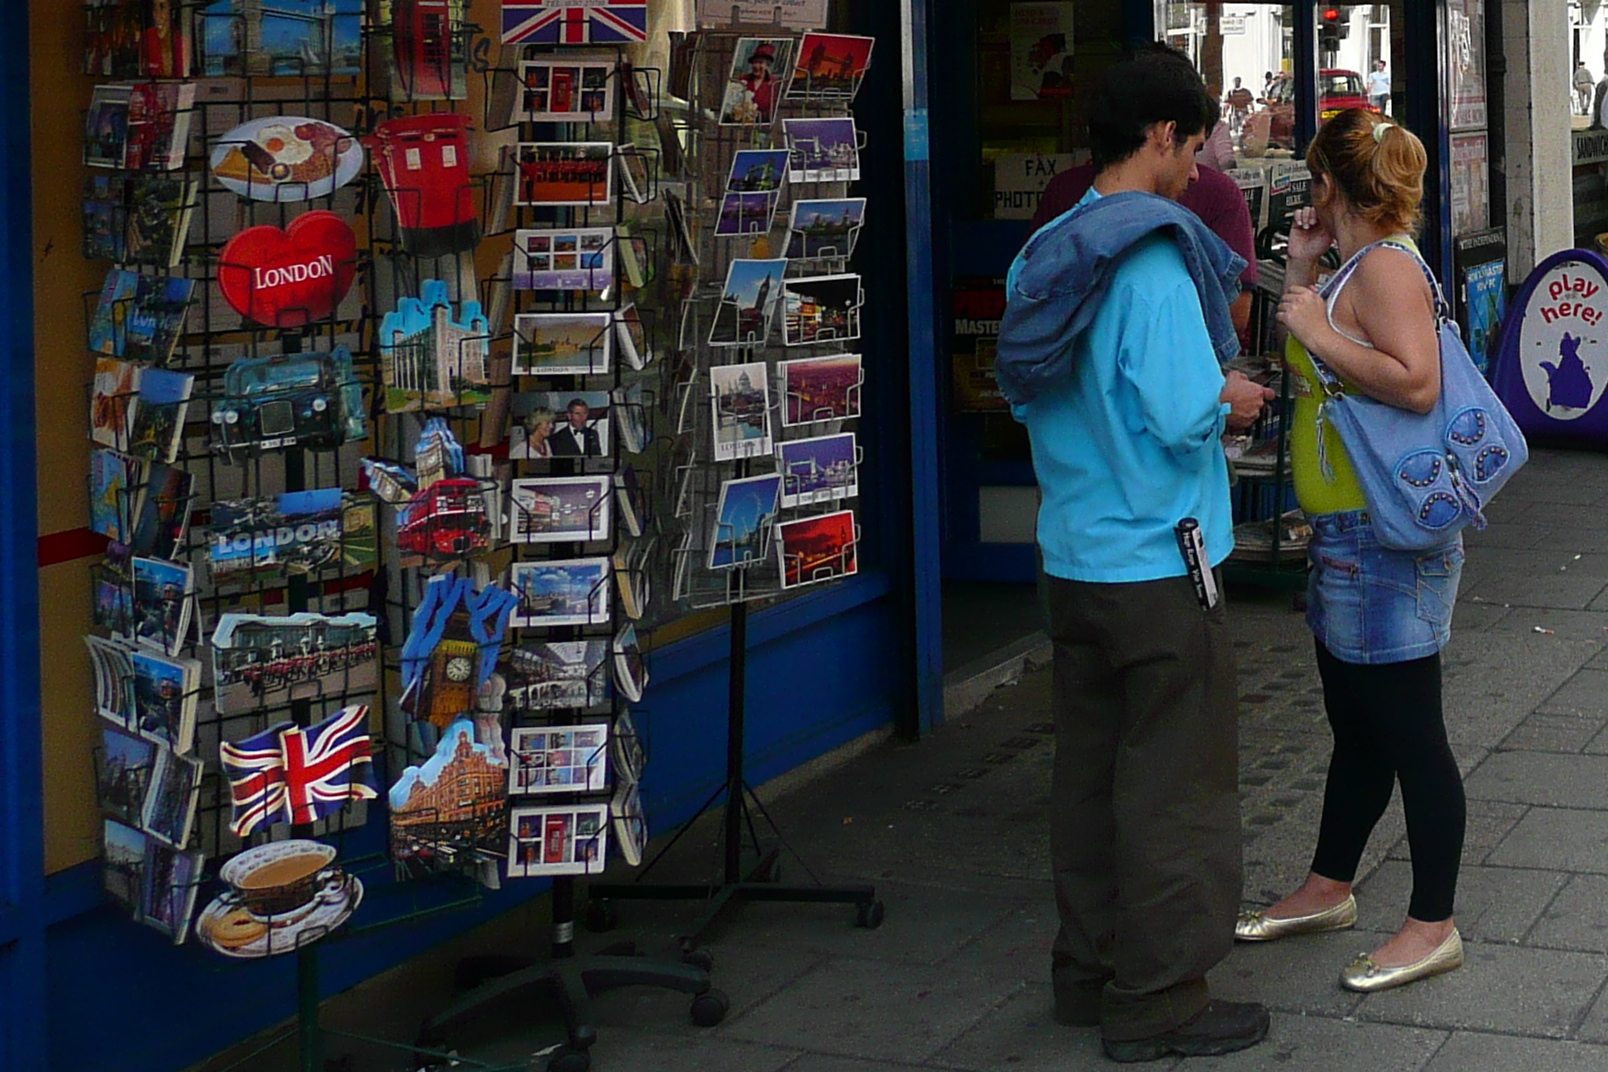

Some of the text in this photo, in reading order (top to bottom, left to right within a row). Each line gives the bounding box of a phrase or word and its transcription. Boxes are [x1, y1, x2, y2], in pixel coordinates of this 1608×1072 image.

[1026, 159, 1057, 176] FAX
[254, 254, 334, 290] LONDON
[1549, 273, 1600, 302] play
[1540, 300, 1603, 327] here!
[218, 519, 341, 554] LONDON
